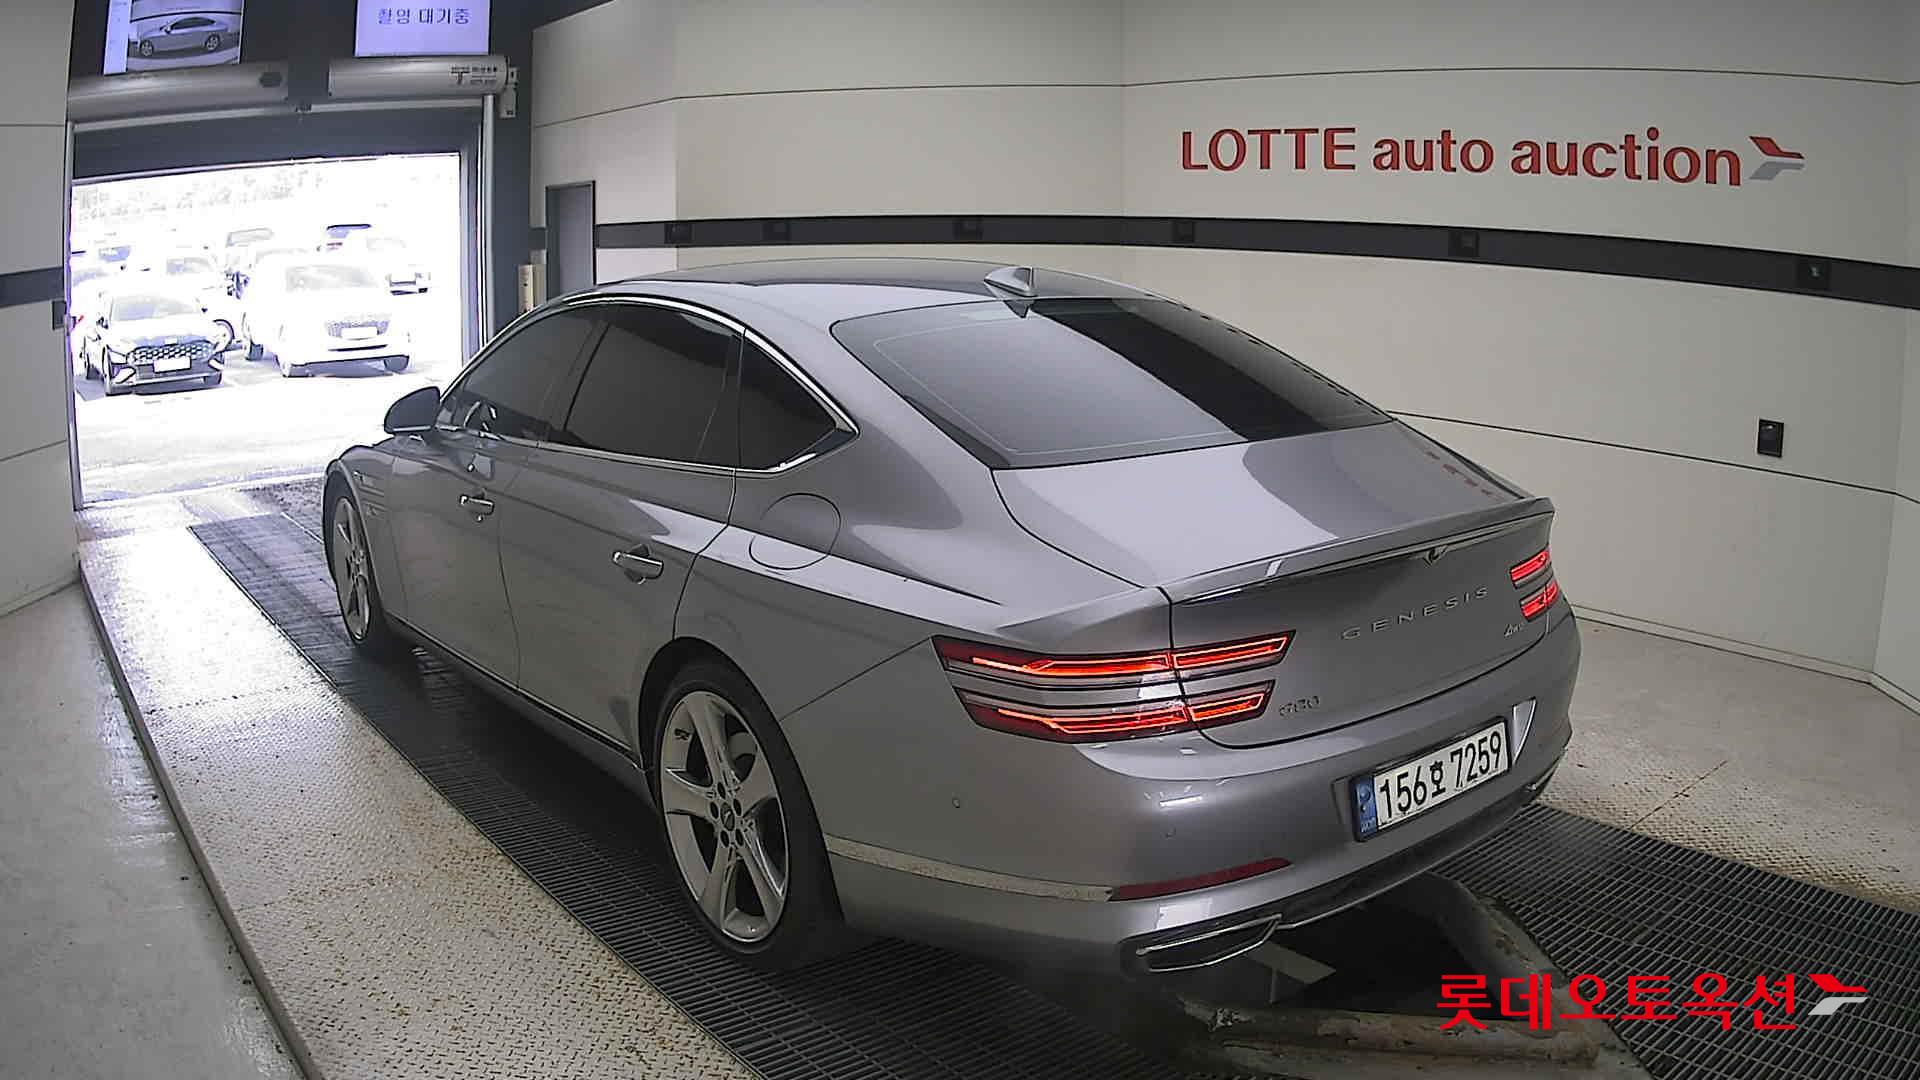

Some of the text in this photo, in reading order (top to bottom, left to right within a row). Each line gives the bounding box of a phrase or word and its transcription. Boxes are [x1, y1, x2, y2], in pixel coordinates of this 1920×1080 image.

[419, 8, 471, 25] 대기중
[1181, 126, 1742, 187] LOTTE auto auction
[1341, 586, 1489, 640] GENESIS
[1379, 731, 1502, 818] 156호 7259
